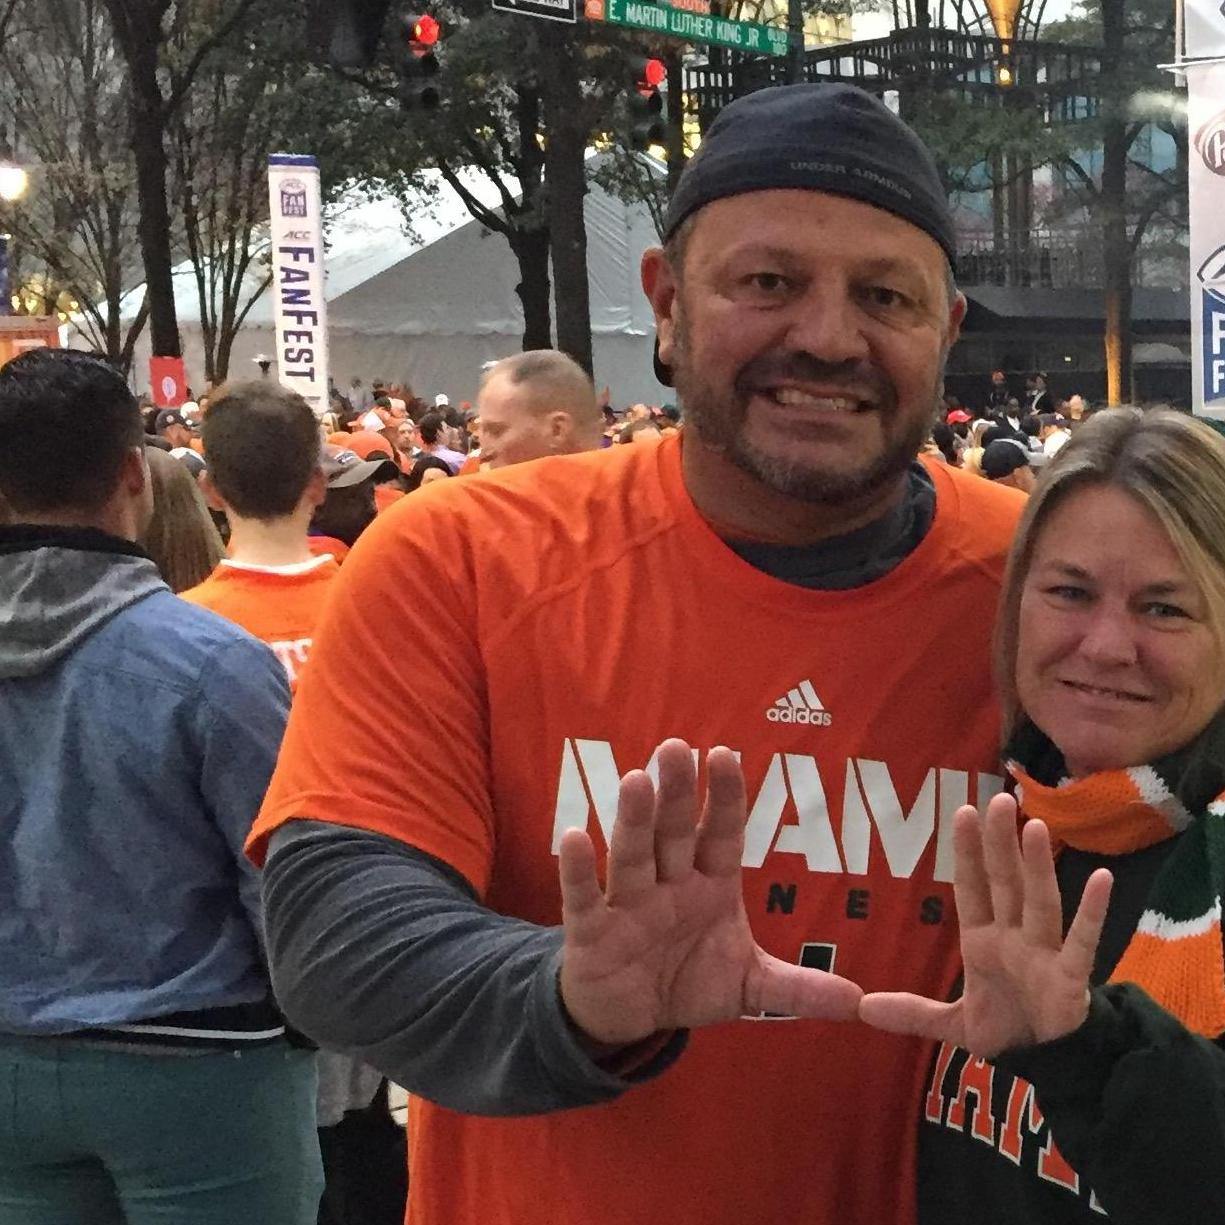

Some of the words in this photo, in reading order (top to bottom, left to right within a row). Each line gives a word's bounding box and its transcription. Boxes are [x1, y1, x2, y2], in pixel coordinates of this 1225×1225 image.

[626, 2, 667, 29] MARTIN
[671, 12, 713, 38] LUTHER
[716, 20, 741, 44] KING
[745, 27, 759, 47] JR
[790, 161, 846, 174] UNDER
[283, 194, 305, 206] FAN
[283, 231, 312, 240] ACC
[766, 706, 832, 726] adidas
